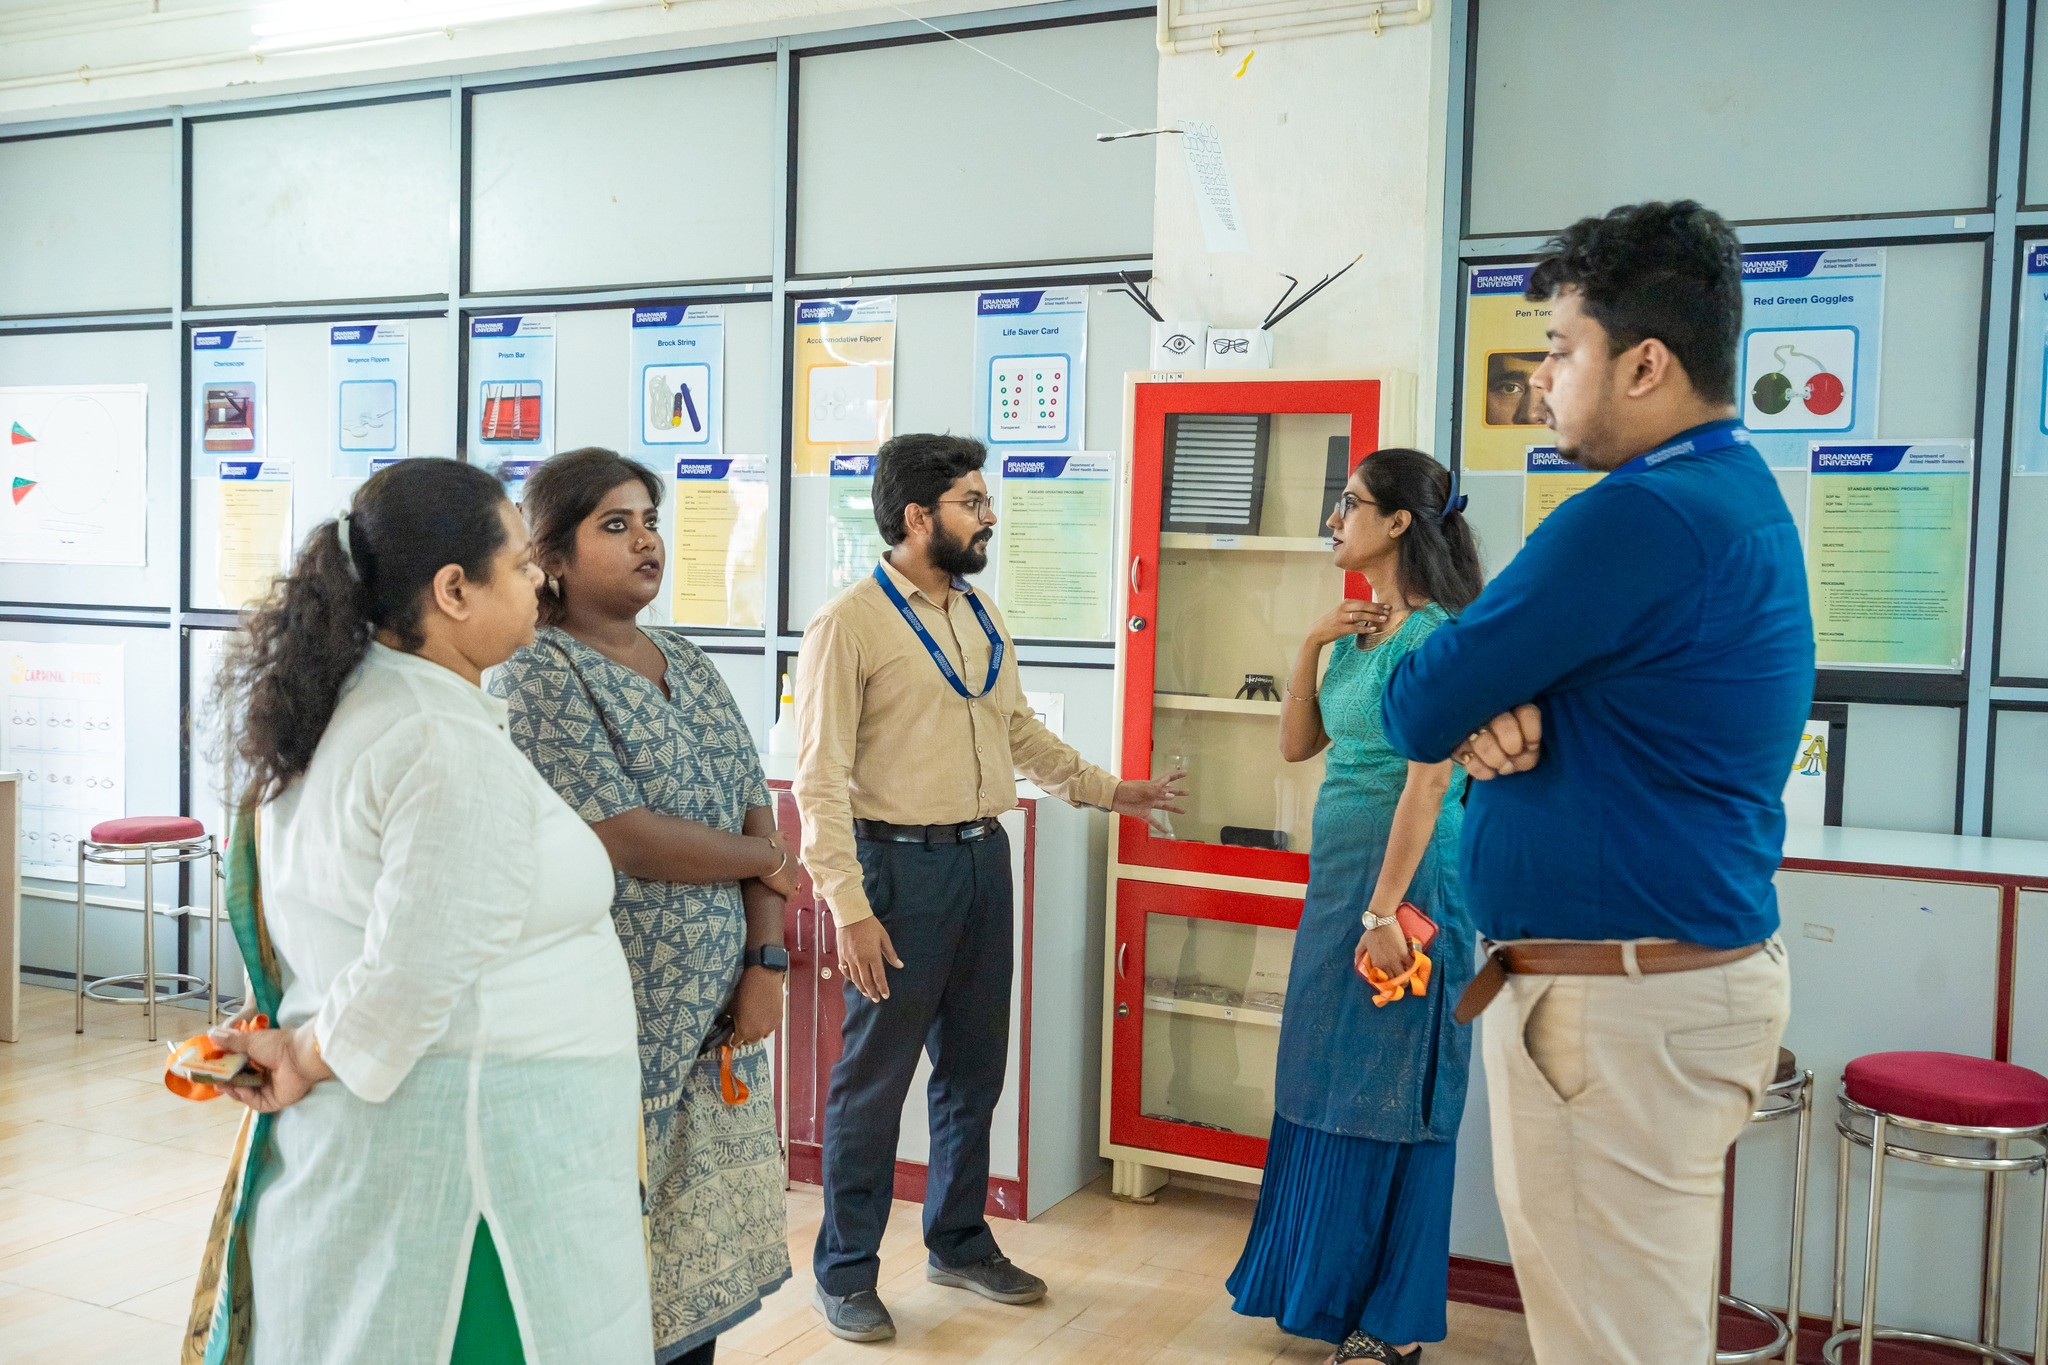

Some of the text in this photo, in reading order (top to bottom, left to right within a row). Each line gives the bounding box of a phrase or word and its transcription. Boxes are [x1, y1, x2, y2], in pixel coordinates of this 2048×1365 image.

[1741, 266, 1788, 274] NIVERSITY
[982, 297, 1020, 305] BRAINWARE
[1753, 294, 1854, 306] Red Green Goggles
[1534, 309, 1553, 317] Torc
[1002, 327, 1059, 336] Life Saver Card
[677, 339, 696, 347] String
[806, 335, 881, 344] Accomodative Flipper
[1819, 453, 1873, 461] BRAINWARE
